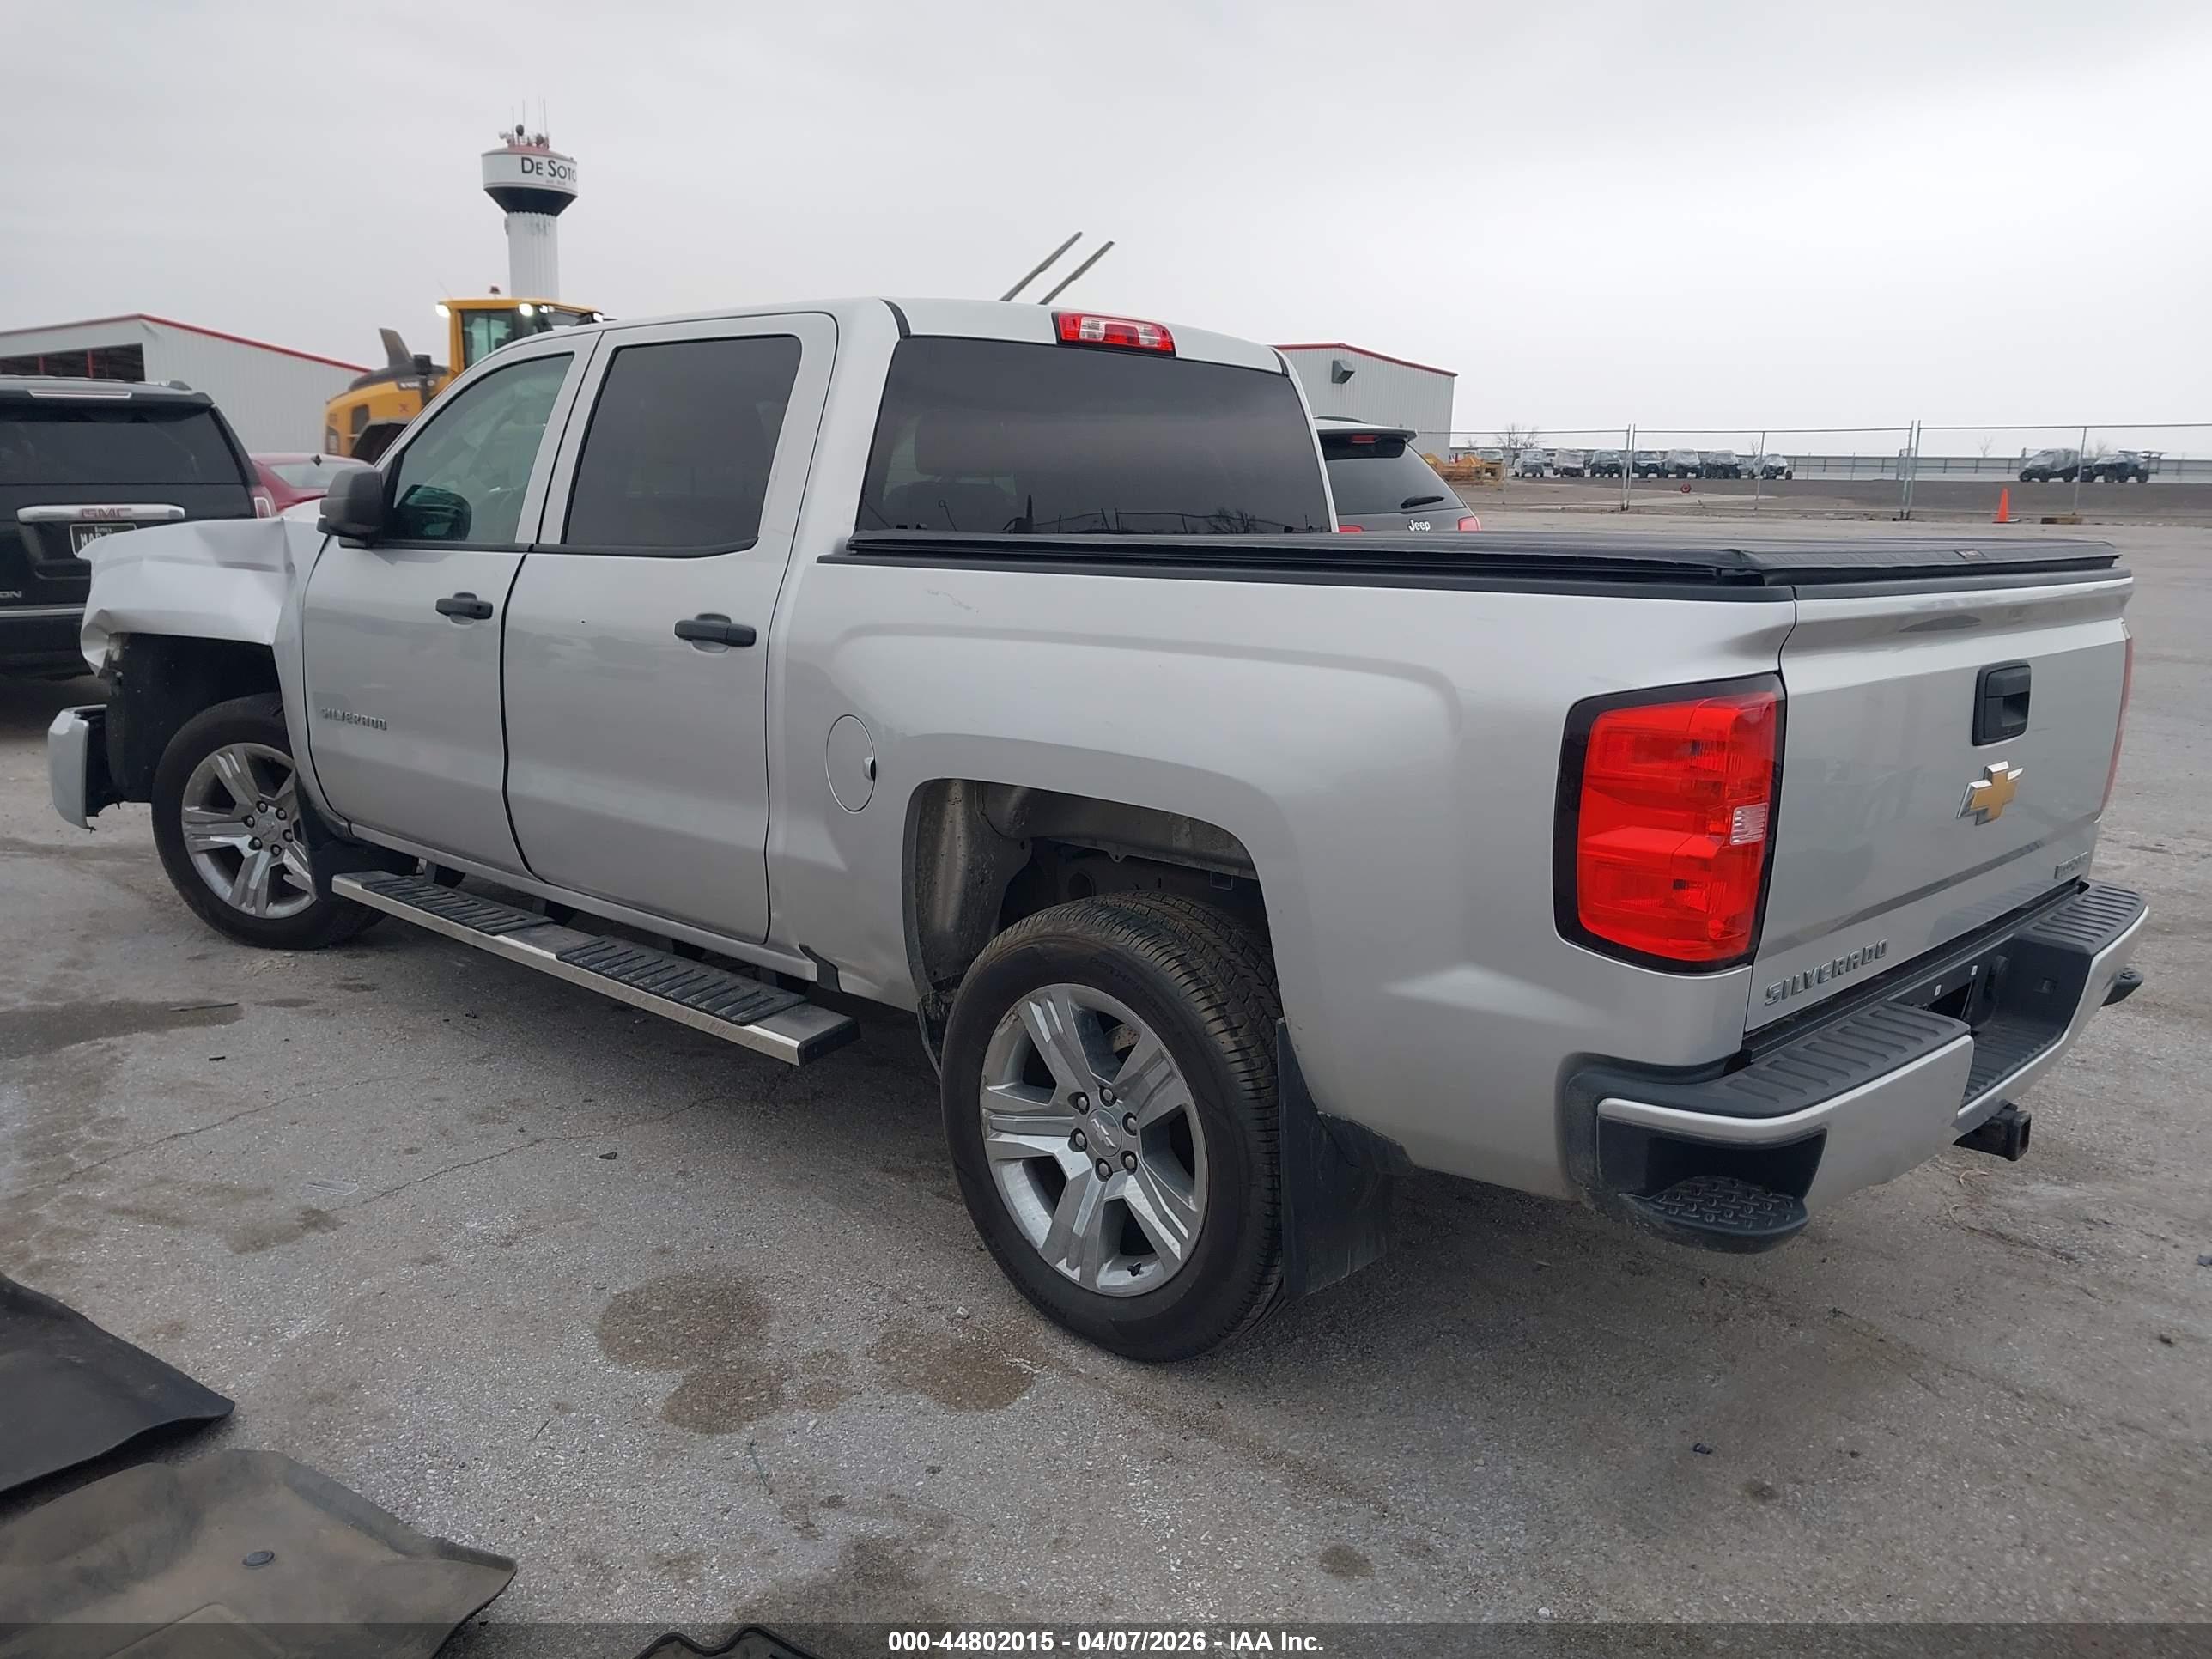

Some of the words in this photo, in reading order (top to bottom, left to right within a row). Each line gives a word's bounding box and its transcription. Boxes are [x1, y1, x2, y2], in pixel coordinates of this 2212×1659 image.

[80, 507, 131, 518] GMC
[1408, 519, 1431, 532] Jeep
[319, 707, 387, 730] SILVERADO
[1765, 939, 1888, 1005] SILVERADO
